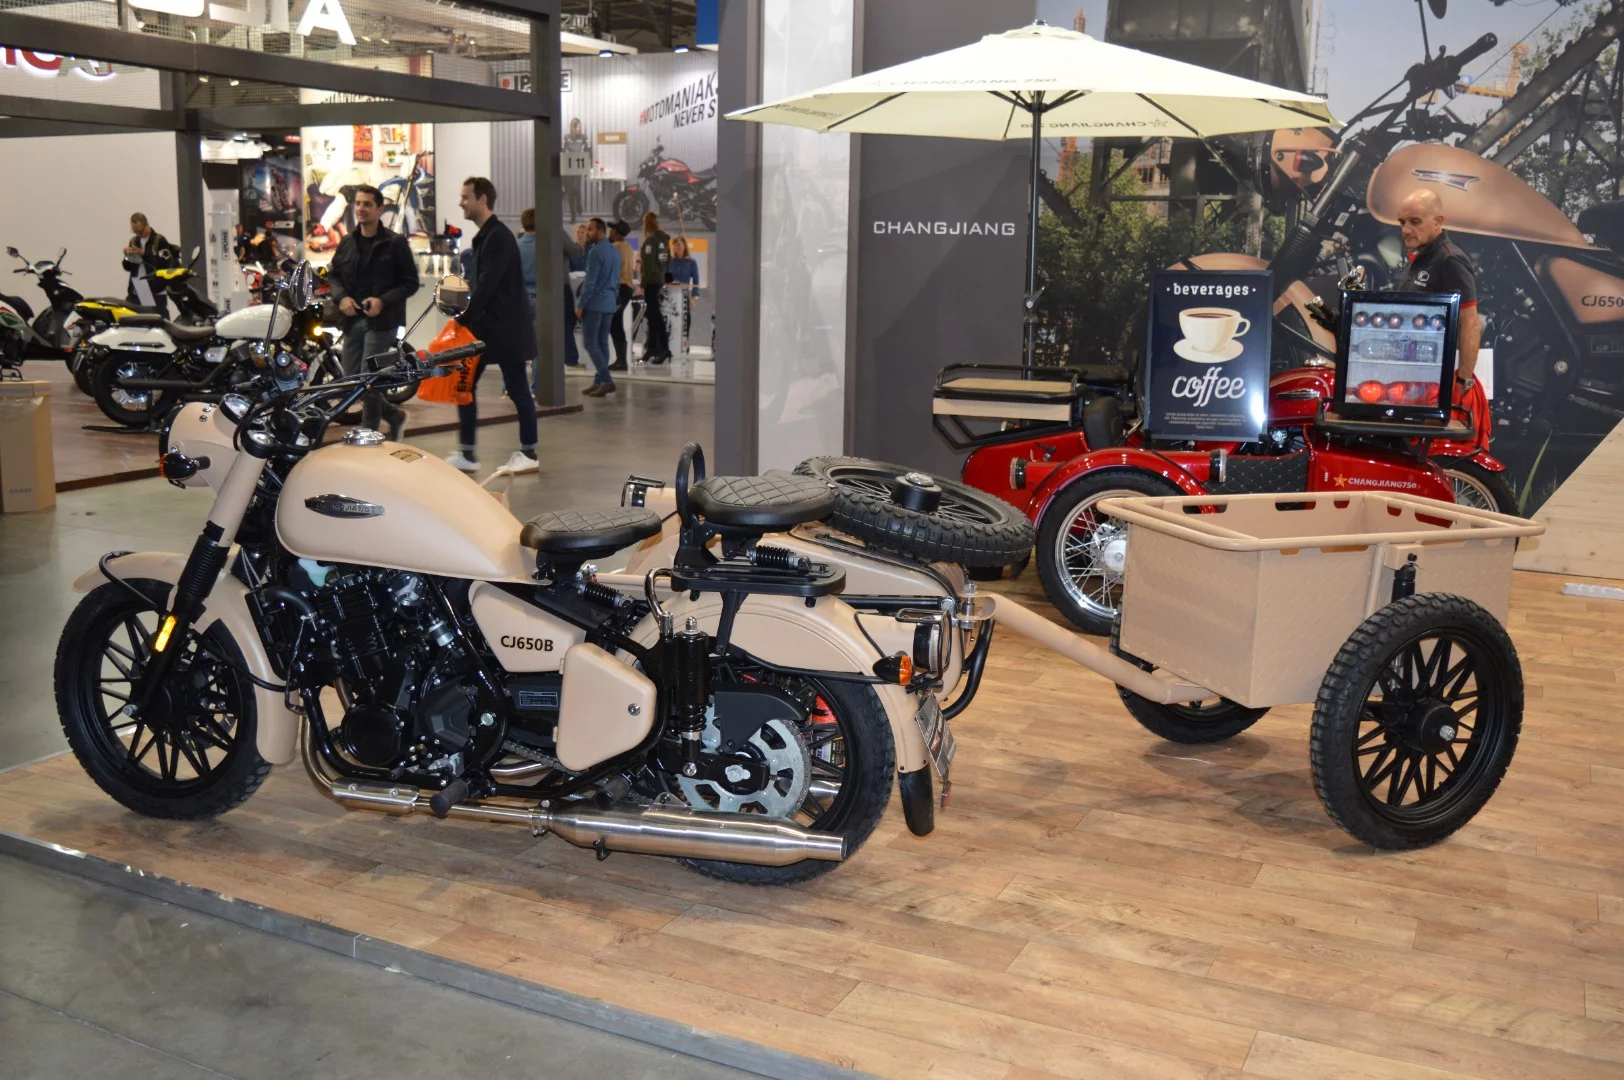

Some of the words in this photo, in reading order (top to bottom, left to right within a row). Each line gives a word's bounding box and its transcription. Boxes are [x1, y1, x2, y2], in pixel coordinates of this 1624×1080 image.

[639, 71, 718, 126] #MOTOMANIAK
[674, 103, 706, 128] NEVER
[576, 157, 585, 169] 11
[873, 221, 1016, 236] CHANGJIANG
[1173, 282, 1249, 298] beverages
[1581, 295, 1624, 308] CJ650
[1171, 366, 1247, 407] coffee
[1348, 477, 1417, 489] CHANGJIANG750
[500, 635, 554, 652] CJ650B
